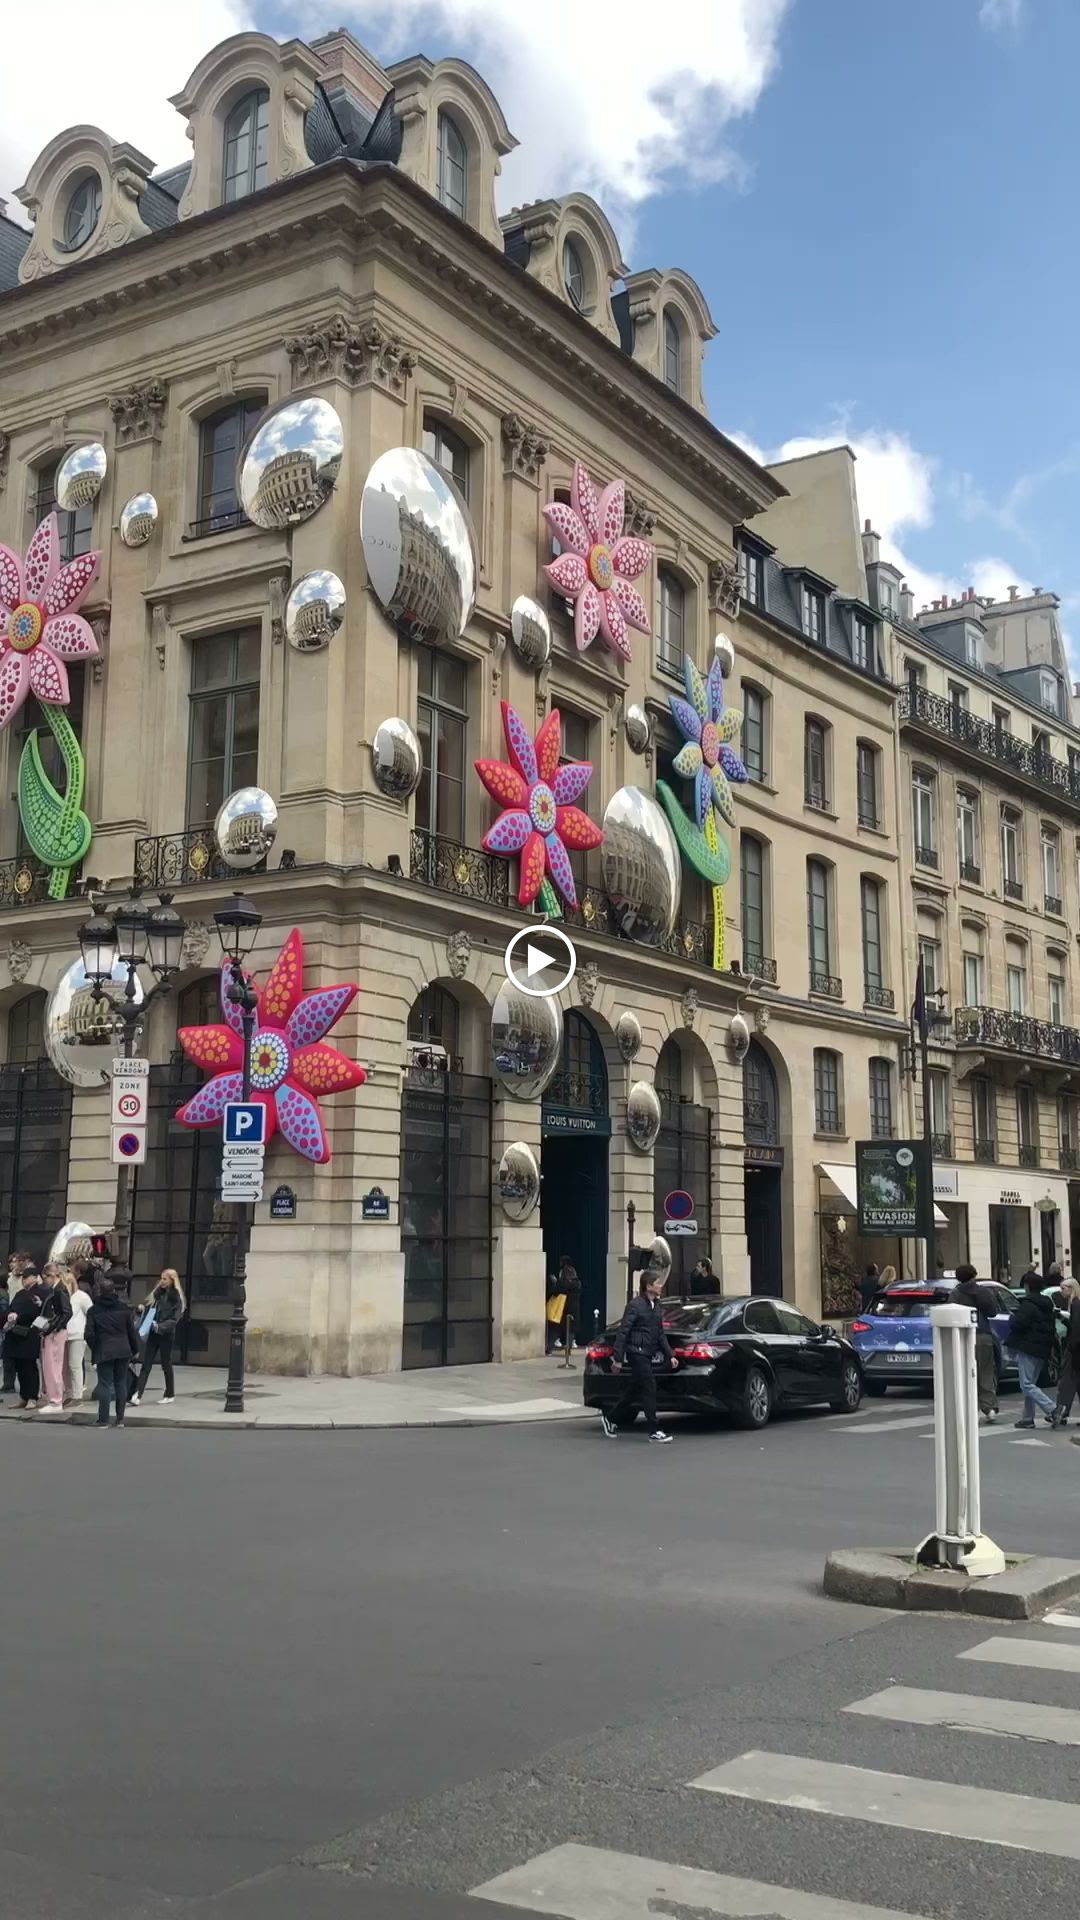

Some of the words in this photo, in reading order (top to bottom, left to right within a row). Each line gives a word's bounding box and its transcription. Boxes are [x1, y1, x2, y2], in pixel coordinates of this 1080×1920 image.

[123, 1100, 137, 1111] 30
[235, 1111, 254, 1136] P
[546, 1115, 567, 1126] LOUIS
[568, 1117, 596, 1129] VUITTON
[227, 1146, 260, 1155] VENDÔME
